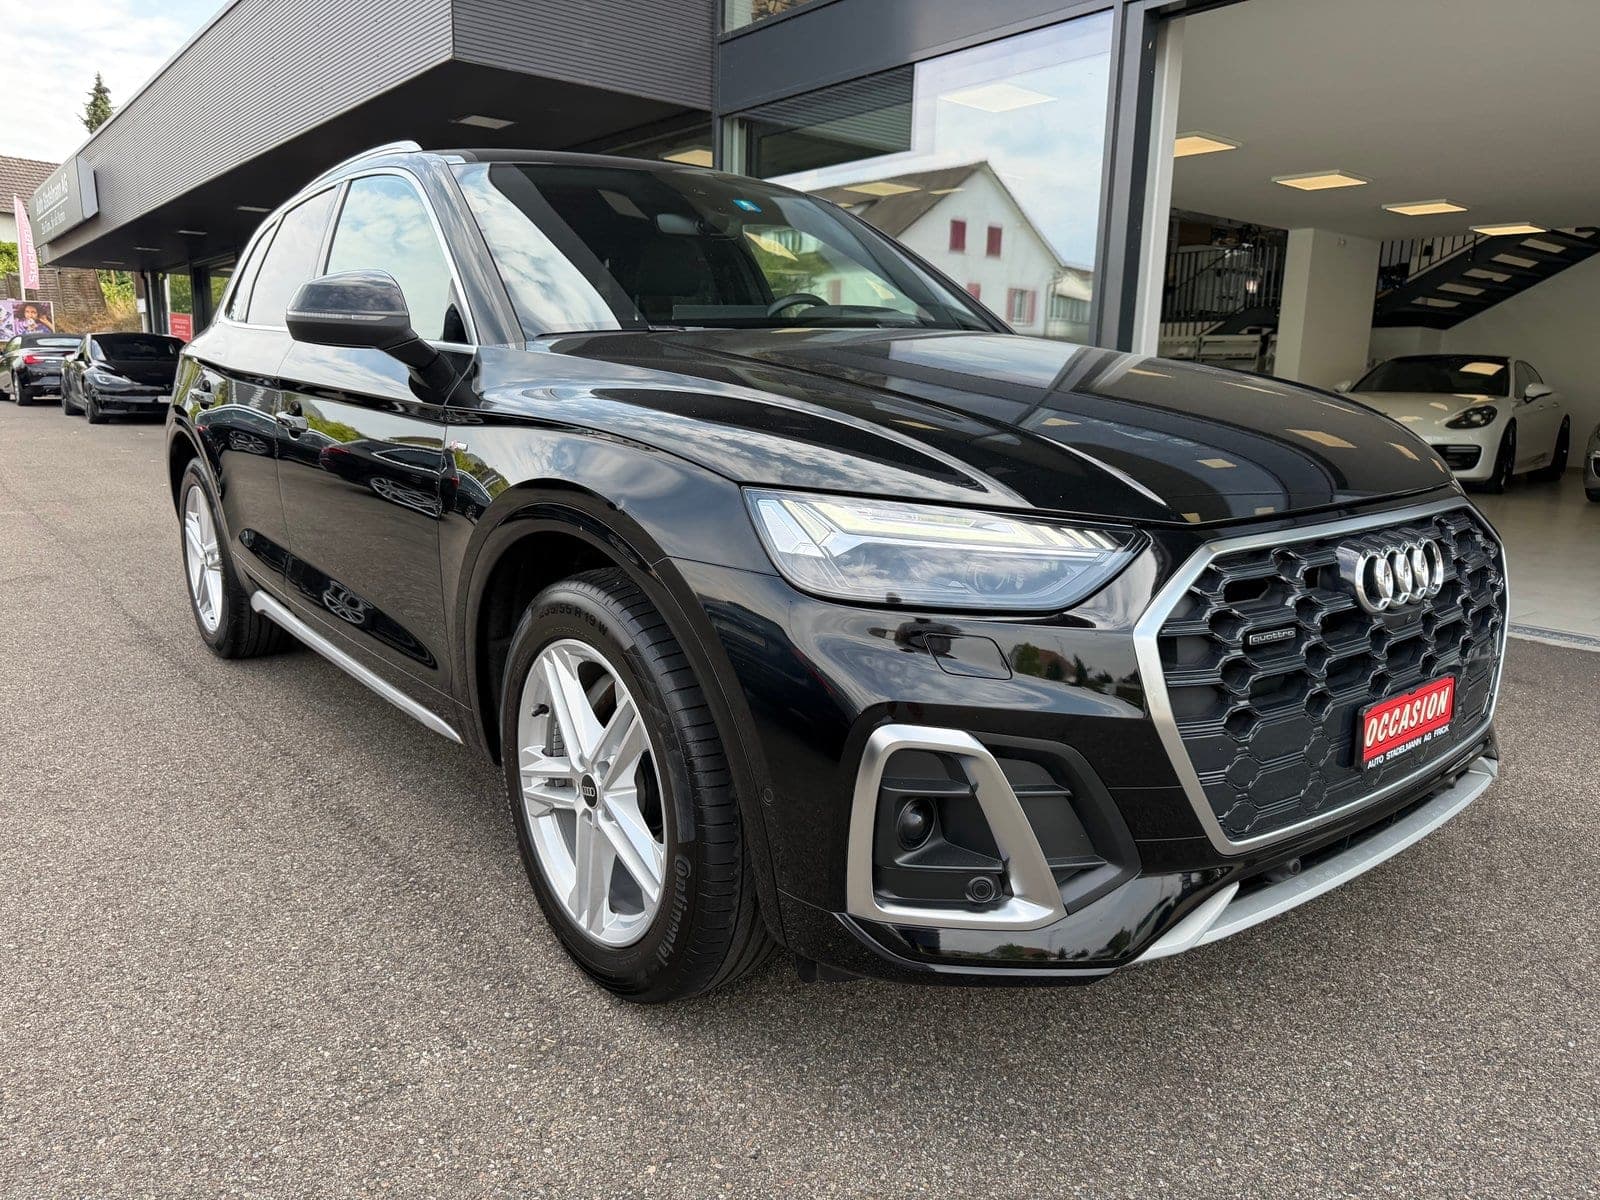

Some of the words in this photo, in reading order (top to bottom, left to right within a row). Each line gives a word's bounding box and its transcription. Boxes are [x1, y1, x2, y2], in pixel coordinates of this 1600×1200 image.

[1250, 629, 1296, 645] quattro
[1365, 687, 1450, 747] OCCASION
[1367, 754, 1384, 769] AUTO
[1386, 737, 1422, 760] STADELMANN
[1423, 732, 1432, 743] AG
[1433, 724, 1450, 738] FRICK
